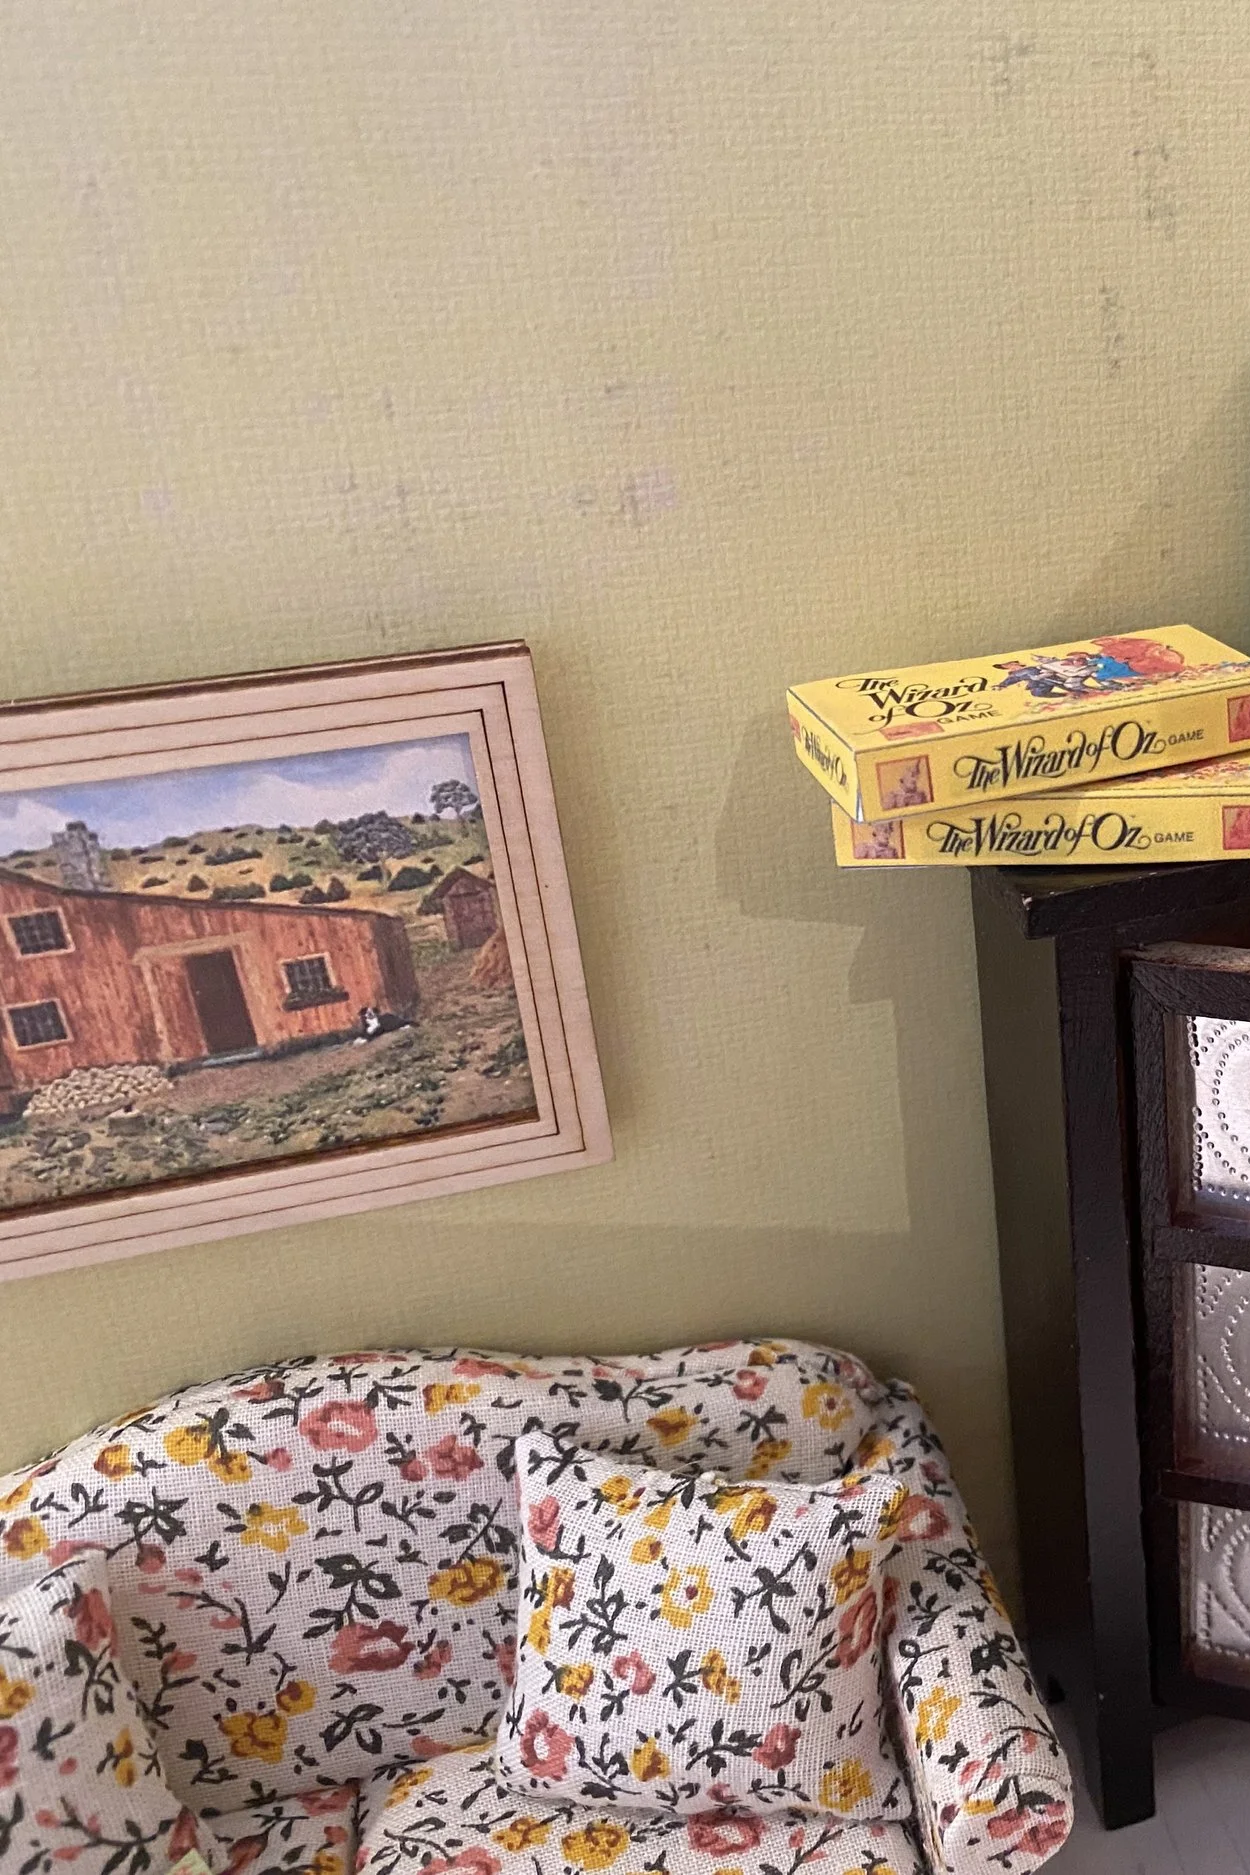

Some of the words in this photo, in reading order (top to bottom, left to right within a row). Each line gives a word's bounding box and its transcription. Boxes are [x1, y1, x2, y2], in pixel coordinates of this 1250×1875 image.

[835, 677, 899, 692] The
[859, 676, 988, 710] Wizard
[853, 705, 905, 735] of
[905, 700, 993, 718] Oz
[937, 709, 1003, 724] GAME
[953, 755, 1001, 792] The
[996, 730, 1087, 788] Wizard
[1086, 725, 1115, 772] of
[1111, 720, 1167, 760] Oz
[1168, 728, 1205, 746] GAME
[926, 820, 975, 857] The
[969, 812, 1065, 857] Wizard
[1063, 813, 1096, 856] of
[1092, 812, 1152, 851] Oz
[1154, 831, 1194, 844] GAME
